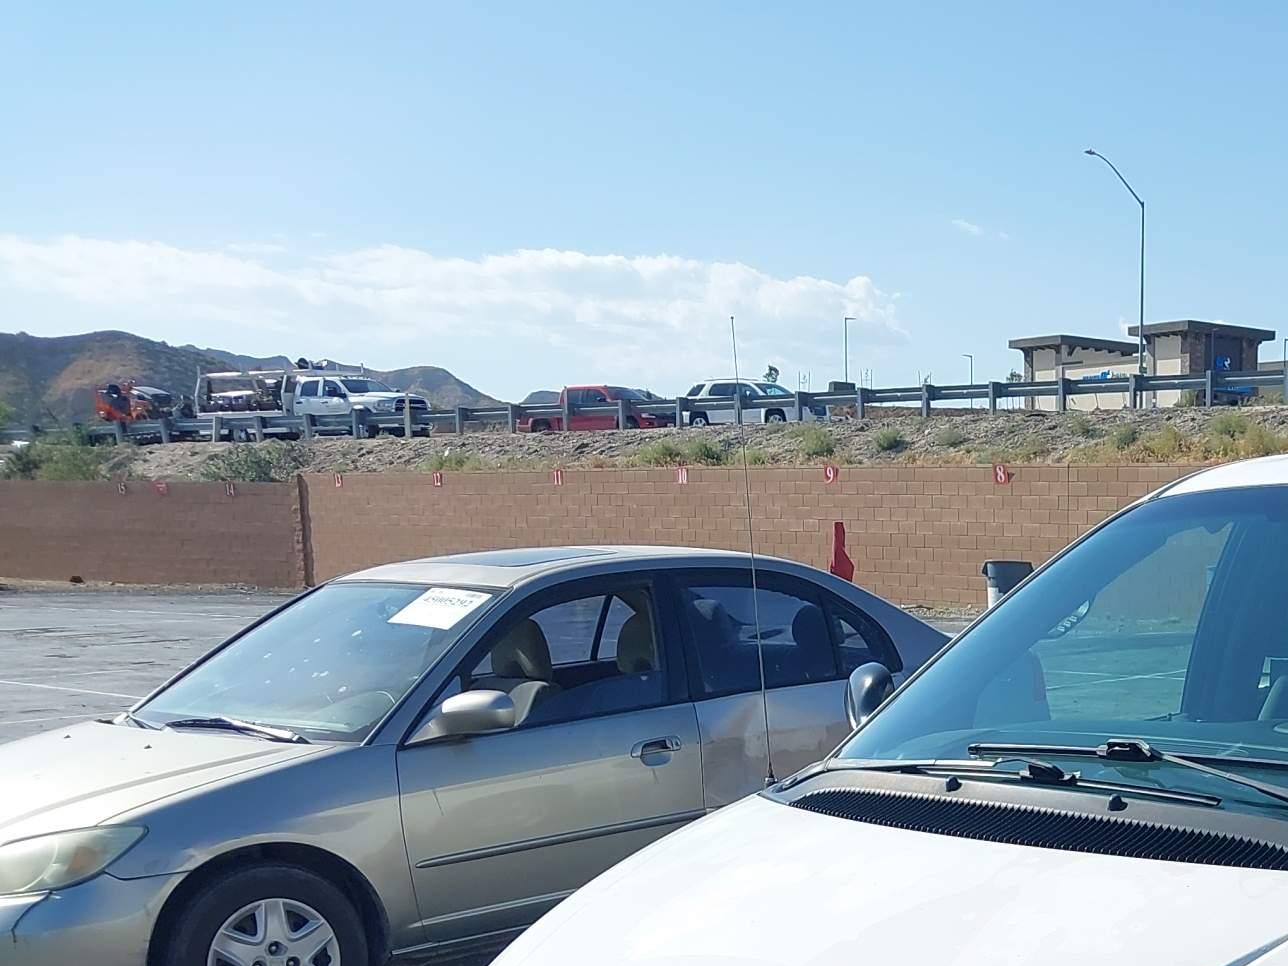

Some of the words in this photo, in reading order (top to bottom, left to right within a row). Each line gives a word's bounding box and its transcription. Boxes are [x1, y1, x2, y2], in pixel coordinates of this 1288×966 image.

[433, 472, 442, 486] 12
[552, 469, 562, 486] 11
[677, 468, 687, 485] 10
[825, 466, 835, 484] 9
[995, 464, 1006, 483] 8
[225, 482, 235, 496] 14
